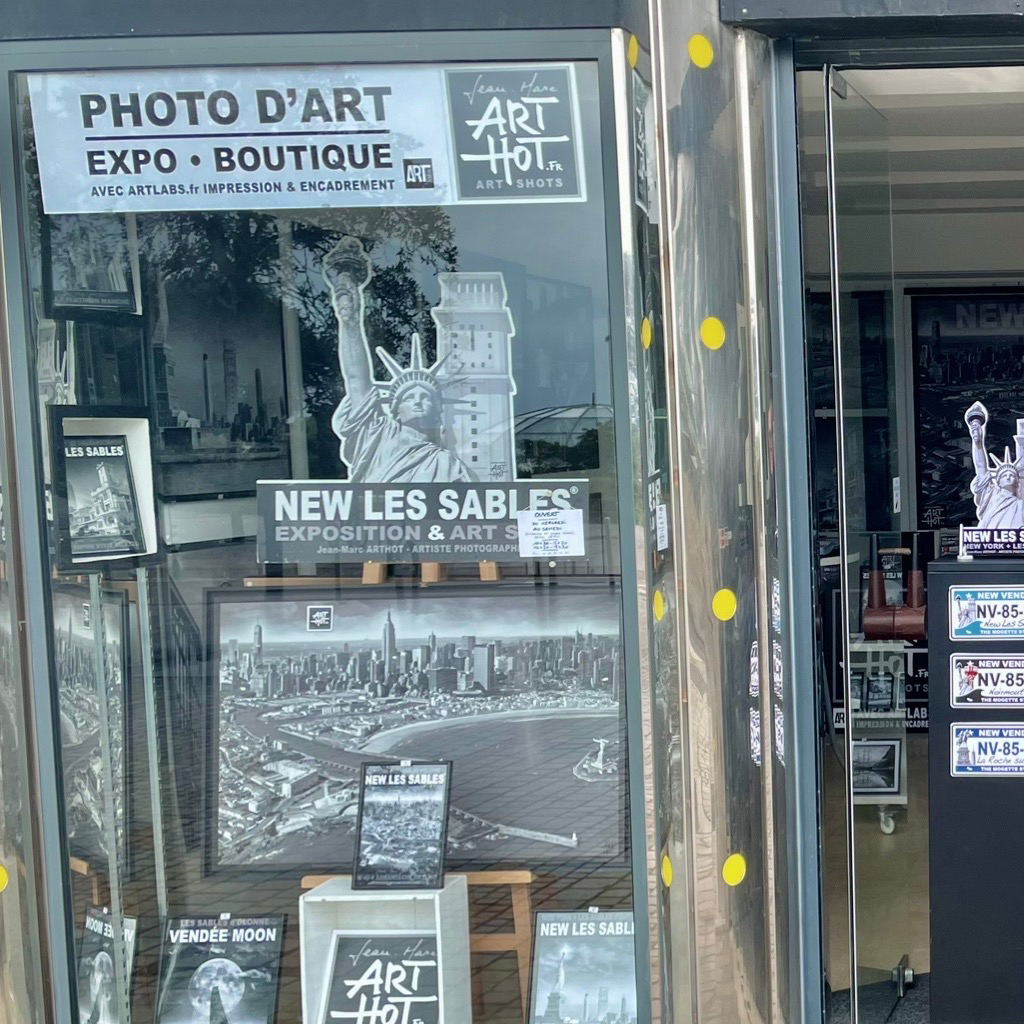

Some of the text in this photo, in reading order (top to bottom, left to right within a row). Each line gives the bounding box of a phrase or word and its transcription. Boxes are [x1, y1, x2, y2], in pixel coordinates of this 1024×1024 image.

[80, 86, 392, 128] PHOTO D'ART
[465, 96, 559, 140] ART
[87, 143, 393, 175] EXPO BOUTIQUE
[91, 180, 395, 197] AVEC ARTLABS.fr IMPRESSION & ENCADREMENT
[476, 178, 563, 189] ART SHOTS
[65, 446, 124, 457] LES SABLES
[274, 490, 351, 521] NEW
[364, 490, 427, 521] LES
[275, 526, 421, 541] EXPOSITION
[427, 525, 445, 541] &
[450, 525, 496, 541] ART
[963, 531, 991, 542] NEW
[994, 531, 1017, 542] LES
[317, 545, 363, 554] Jean-Marc
[366, 545, 403, 554] ARTHOT
[412, 545, 452, 554] ARTISTE
[1002, 619, 1016, 627] Les
[365, 773, 445, 785] NEW LES SABLES
[169, 926, 276, 943] VENDÉE MOON
[540, 922, 634, 936] NEW LES SABL
[343, 959, 437, 999] ART
